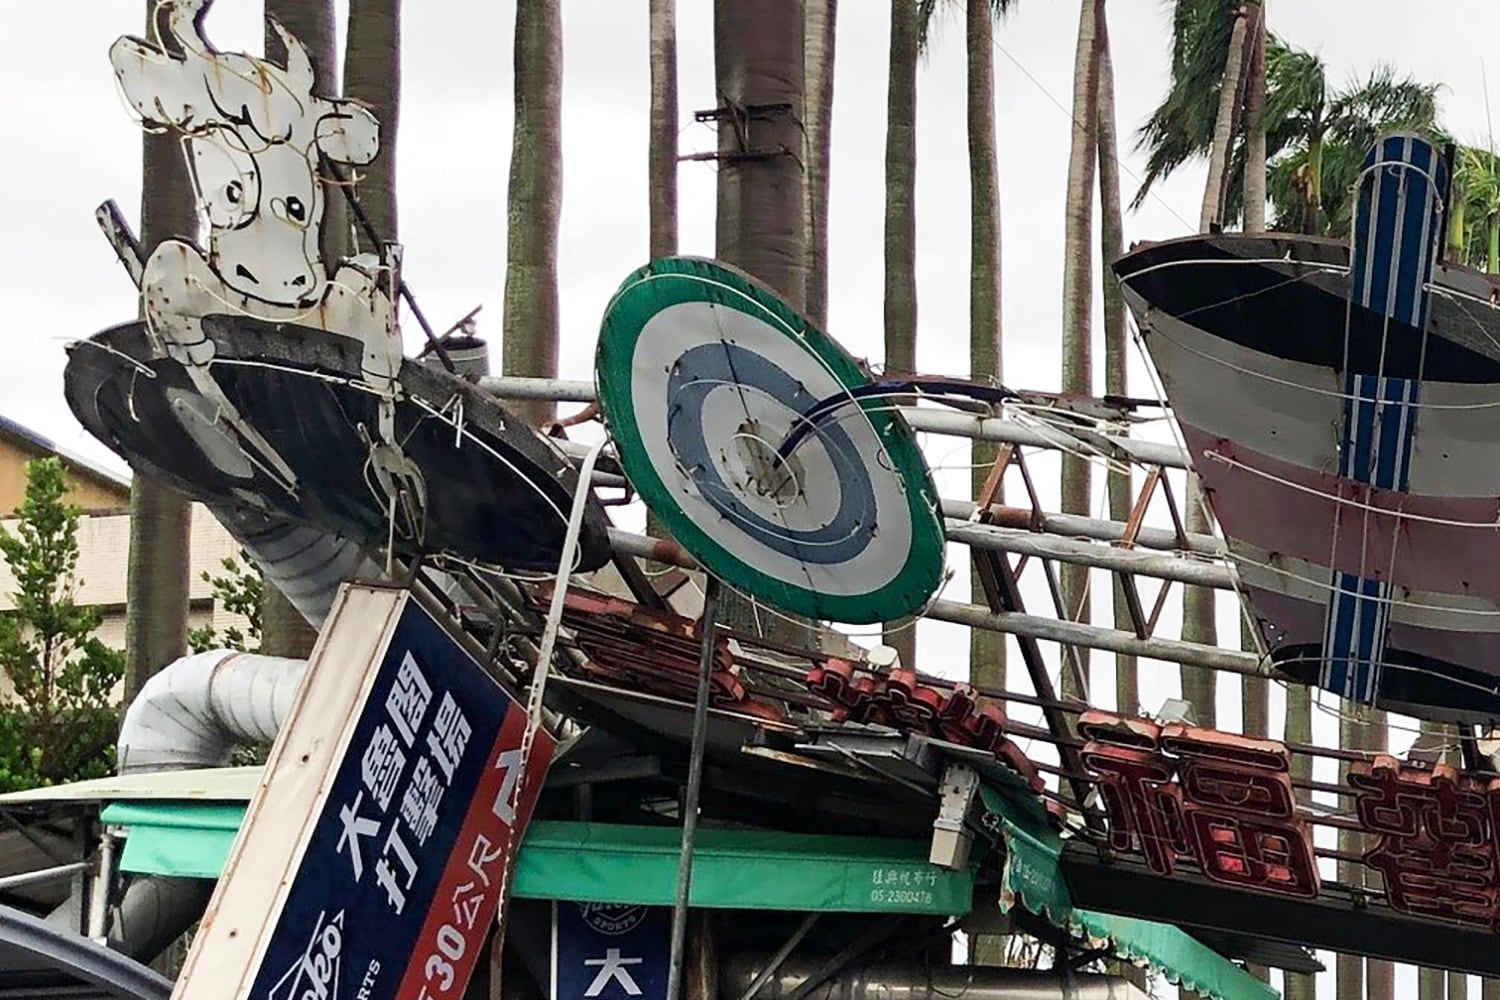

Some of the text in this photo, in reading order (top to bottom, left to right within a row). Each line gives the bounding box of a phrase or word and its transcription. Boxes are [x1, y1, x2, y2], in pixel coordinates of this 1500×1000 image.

[336, 649, 433, 883] 大魯閣
[375, 690, 472, 915] 打擊場
